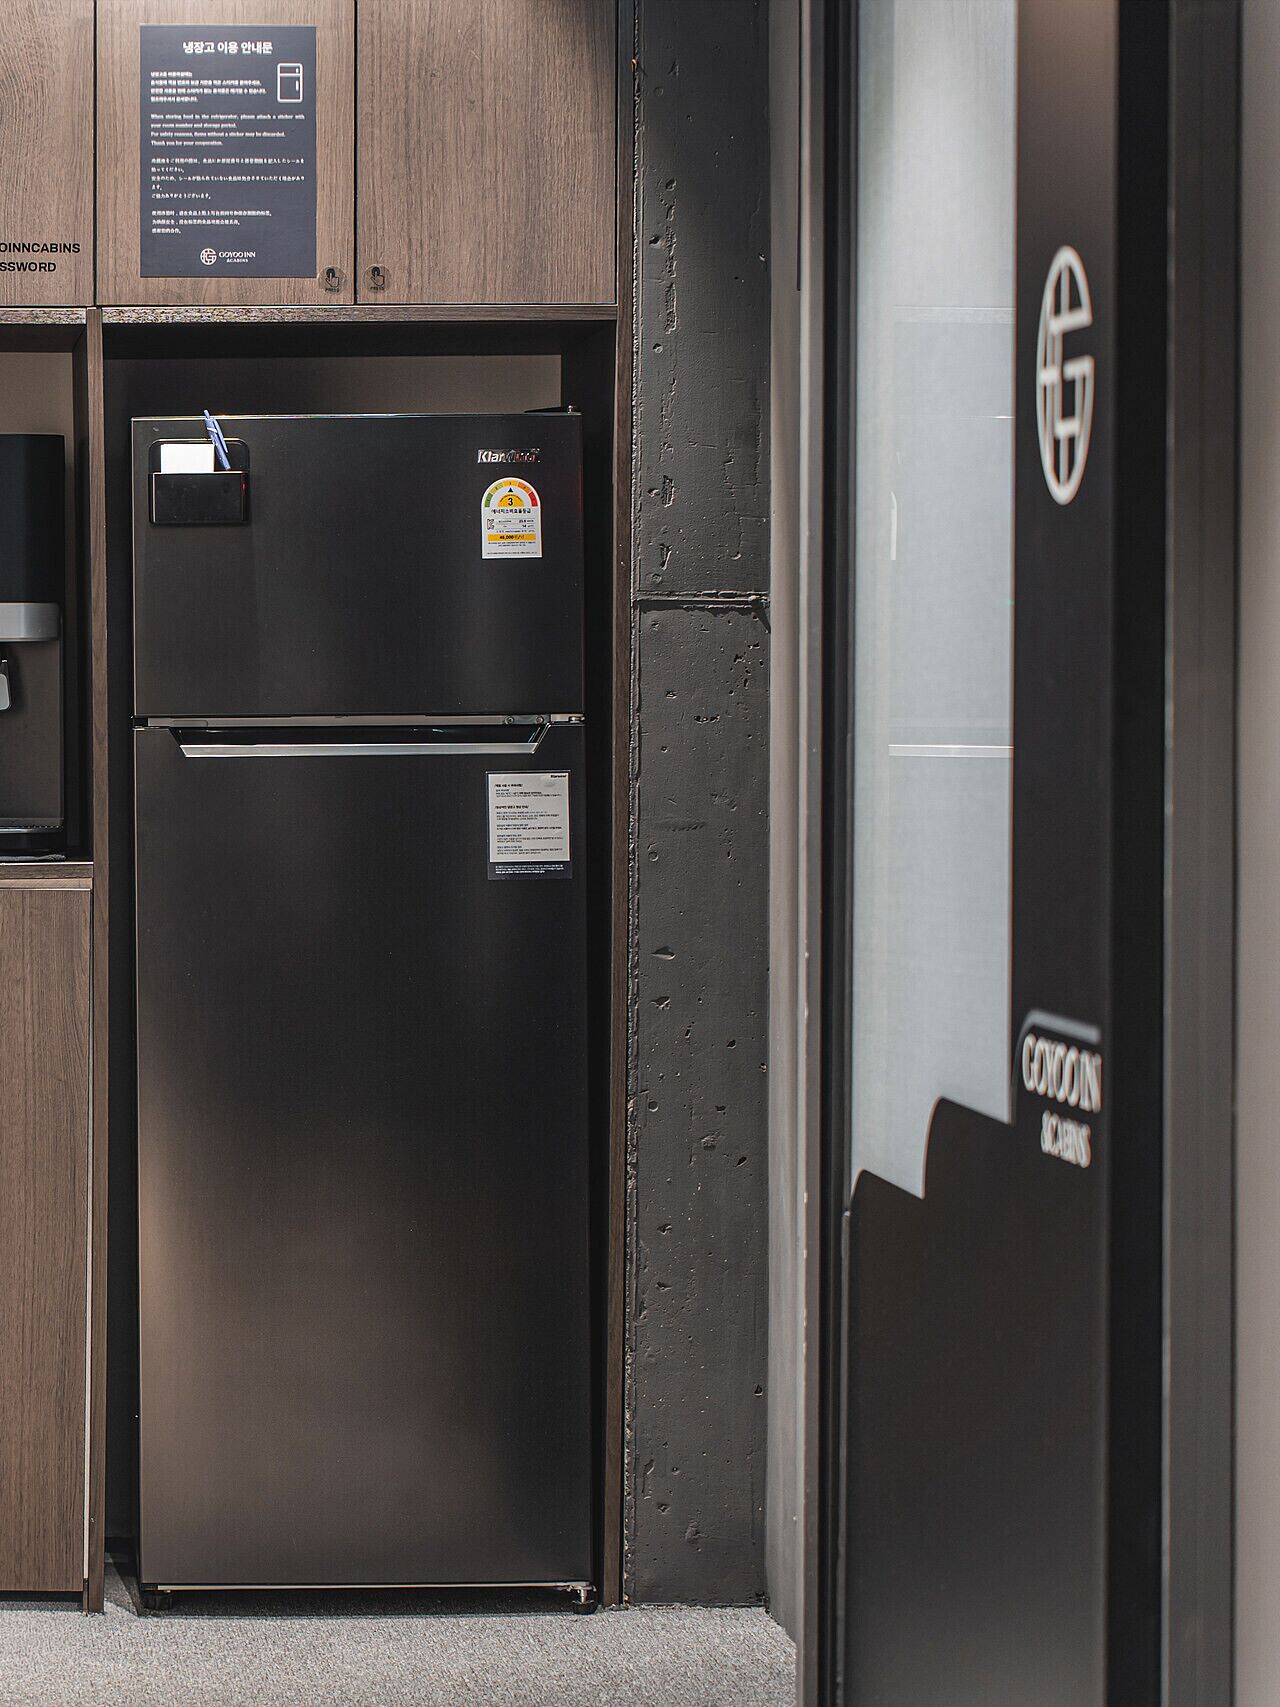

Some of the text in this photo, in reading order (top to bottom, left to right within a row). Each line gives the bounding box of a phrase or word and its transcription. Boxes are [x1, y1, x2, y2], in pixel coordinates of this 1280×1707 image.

[183, 41, 273, 54] 냉장고 이용 안내문
[508, 497, 513, 506] 3
